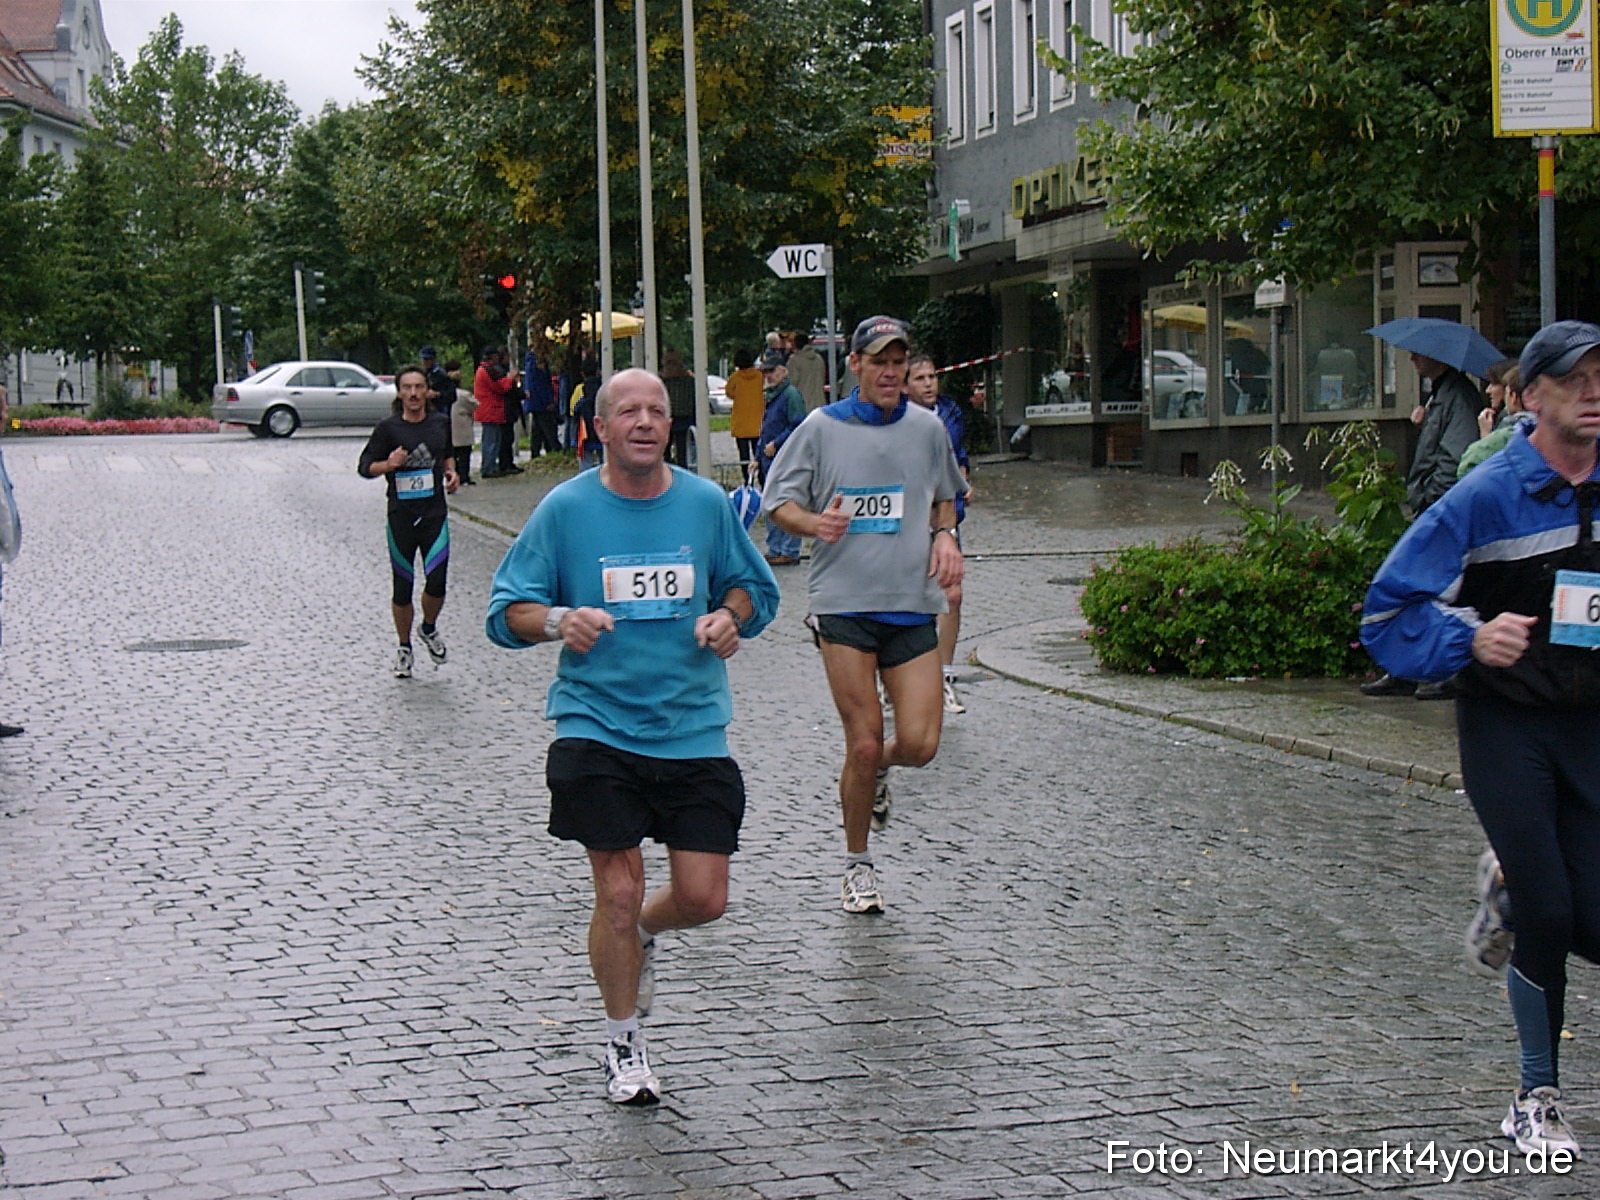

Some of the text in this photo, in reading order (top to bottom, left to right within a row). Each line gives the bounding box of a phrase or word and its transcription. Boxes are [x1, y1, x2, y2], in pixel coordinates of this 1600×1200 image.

[1505, 46, 1584, 59] Oberer Markt
[784, 249, 818, 273] WC
[854, 495, 891, 516] 209
[632, 570, 678, 598] 518
